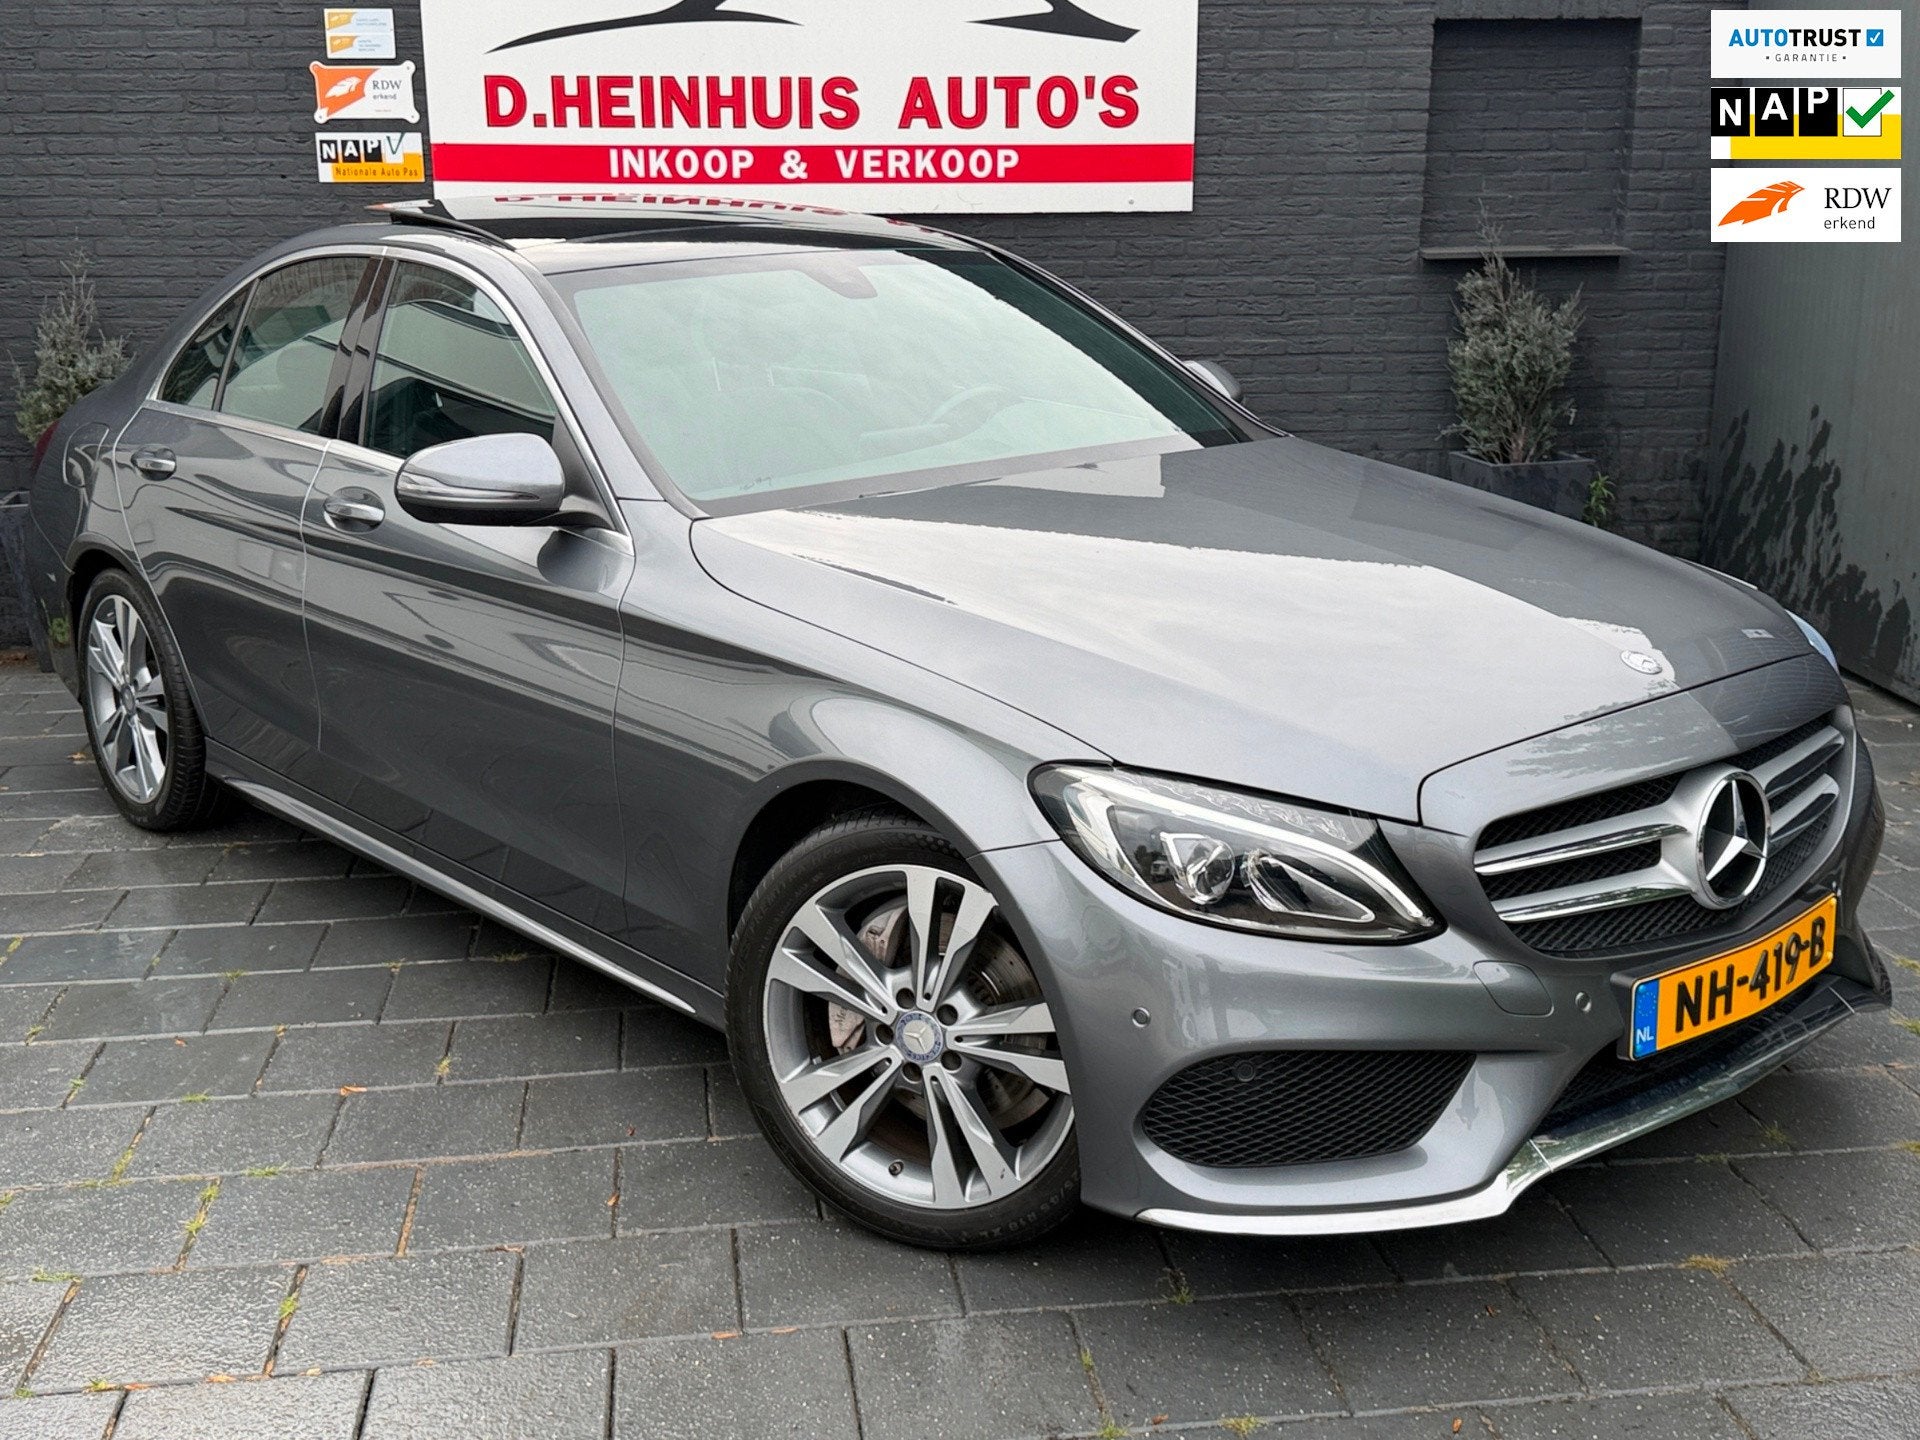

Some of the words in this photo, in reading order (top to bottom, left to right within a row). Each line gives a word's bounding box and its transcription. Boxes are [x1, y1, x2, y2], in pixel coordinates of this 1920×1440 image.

[372, 80, 402, 90] RDW
[484, 75, 860, 129] D.HEINHUIS
[898, 75, 1139, 129] AUTO'S
[335, 167, 377, 176] Nationale
[381, 167, 400, 176] Auto
[404, 167, 418, 177] Pas
[609, 148, 755, 179] INKOOP
[779, 149, 809, 180] &
[834, 149, 1020, 179] VERKOOP
[1675, 916, 1826, 1033] NH-419-B
[1636, 1026, 1654, 1044] NL
